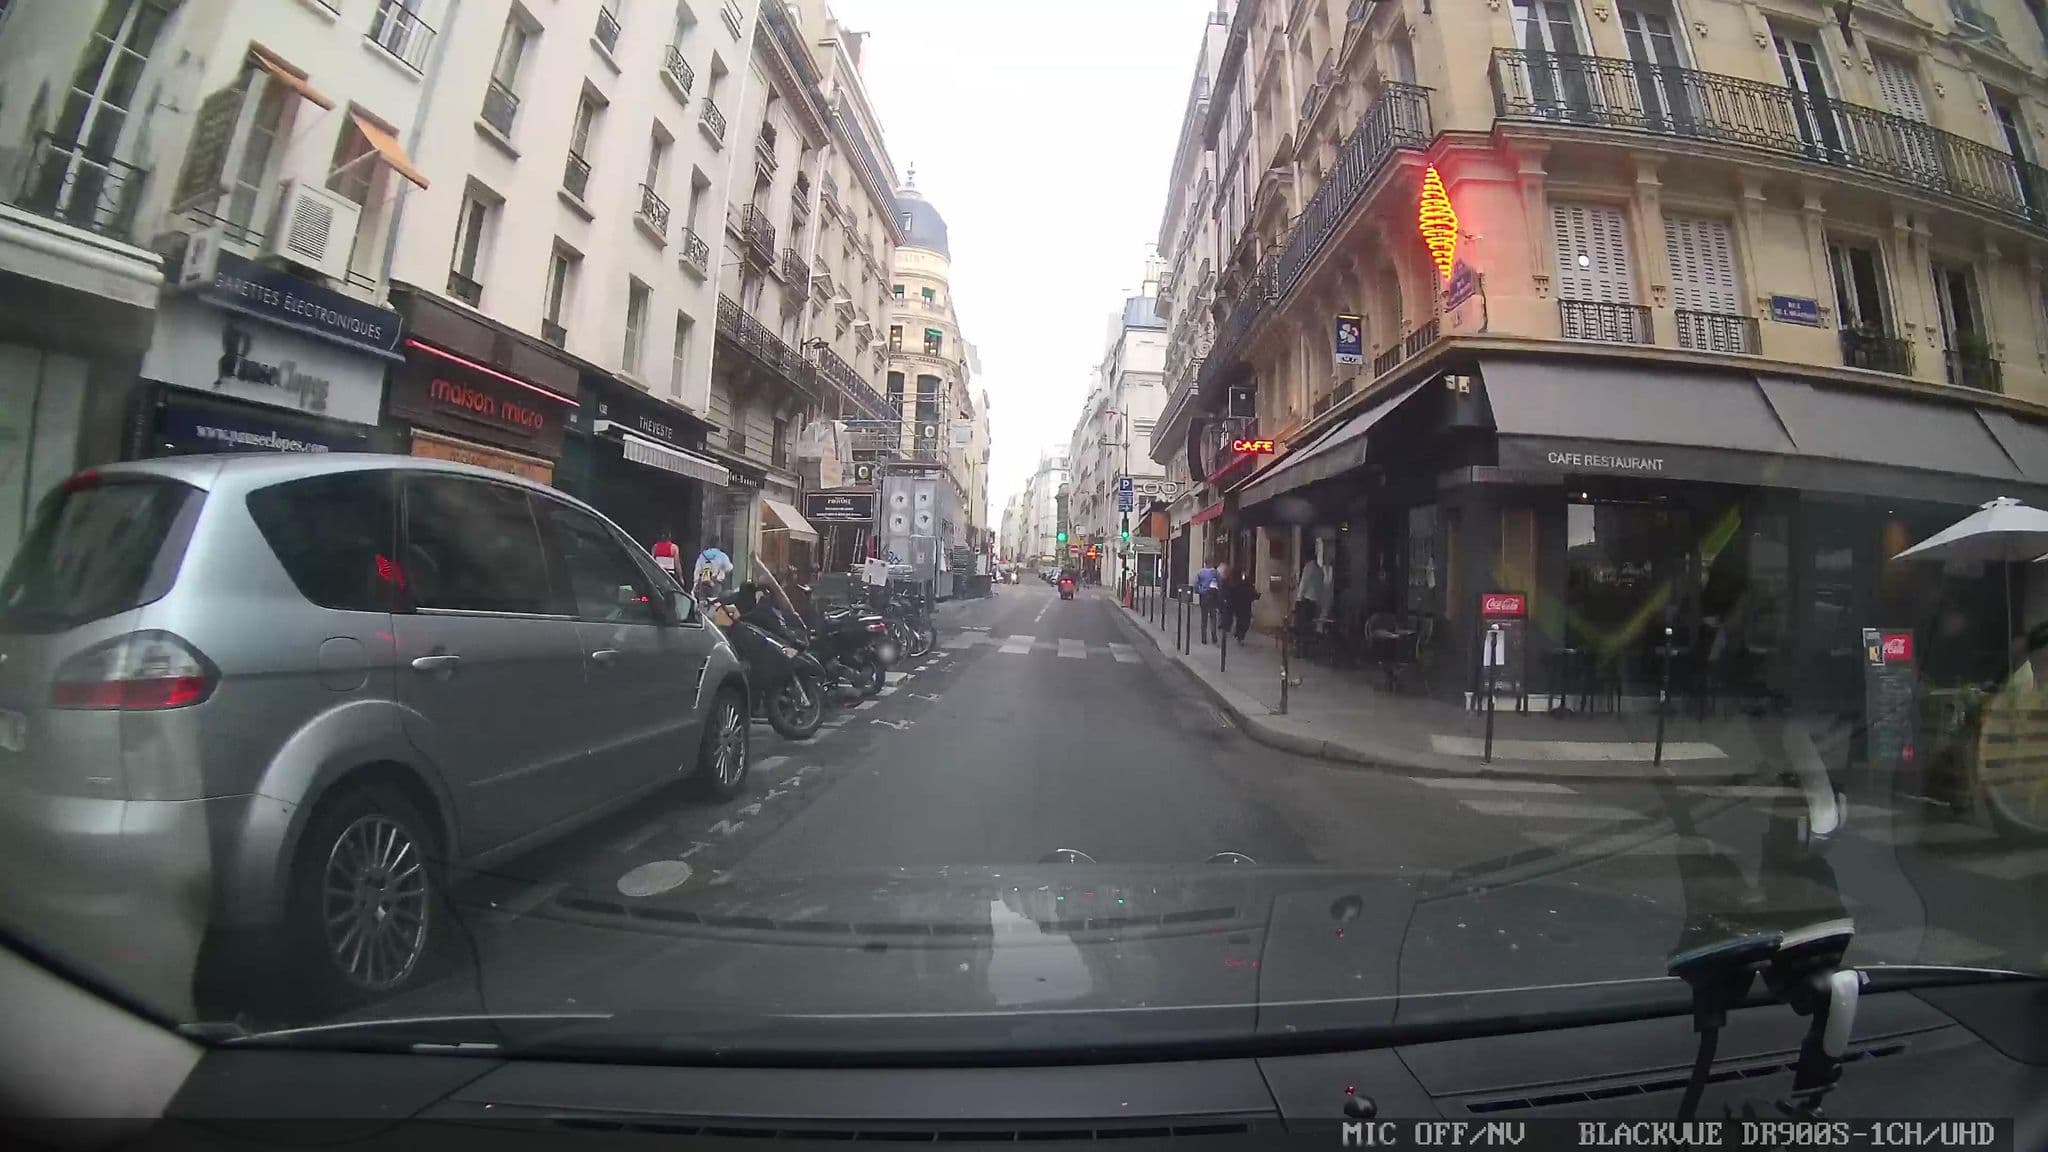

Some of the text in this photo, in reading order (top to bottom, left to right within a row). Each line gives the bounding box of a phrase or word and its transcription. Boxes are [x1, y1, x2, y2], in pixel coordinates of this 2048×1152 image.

[430, 378, 544, 429] maison micro
[1233, 440, 1274, 452] CAFE
[1547, 451, 1664, 471] CAFE RESTAURANT
[1122, 480, 1130, 489] P
